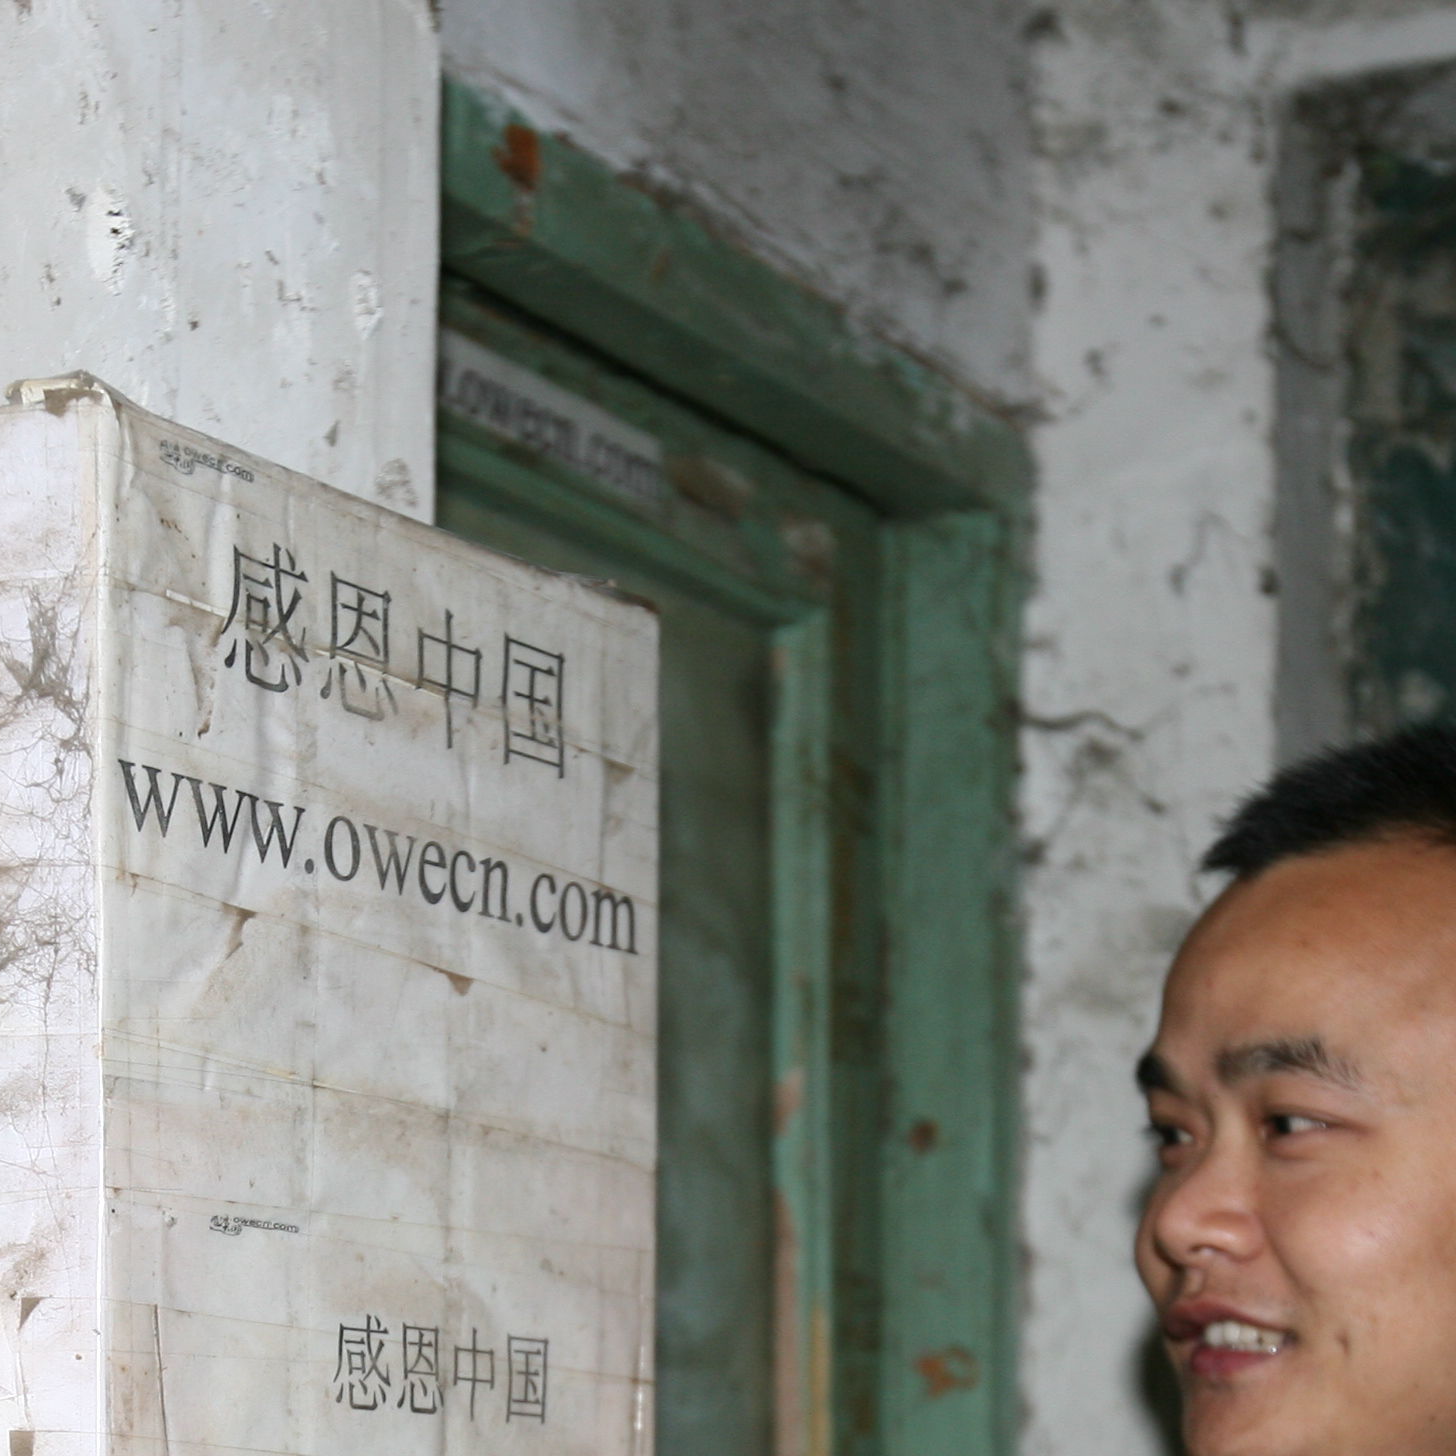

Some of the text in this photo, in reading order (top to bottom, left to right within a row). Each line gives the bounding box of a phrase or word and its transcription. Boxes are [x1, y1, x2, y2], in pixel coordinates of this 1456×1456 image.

[221, 542, 565, 780] 感恩中国
[118, 758, 639, 956] www.owecn.com
[332, 1313, 549, 1425] 感恩中国
